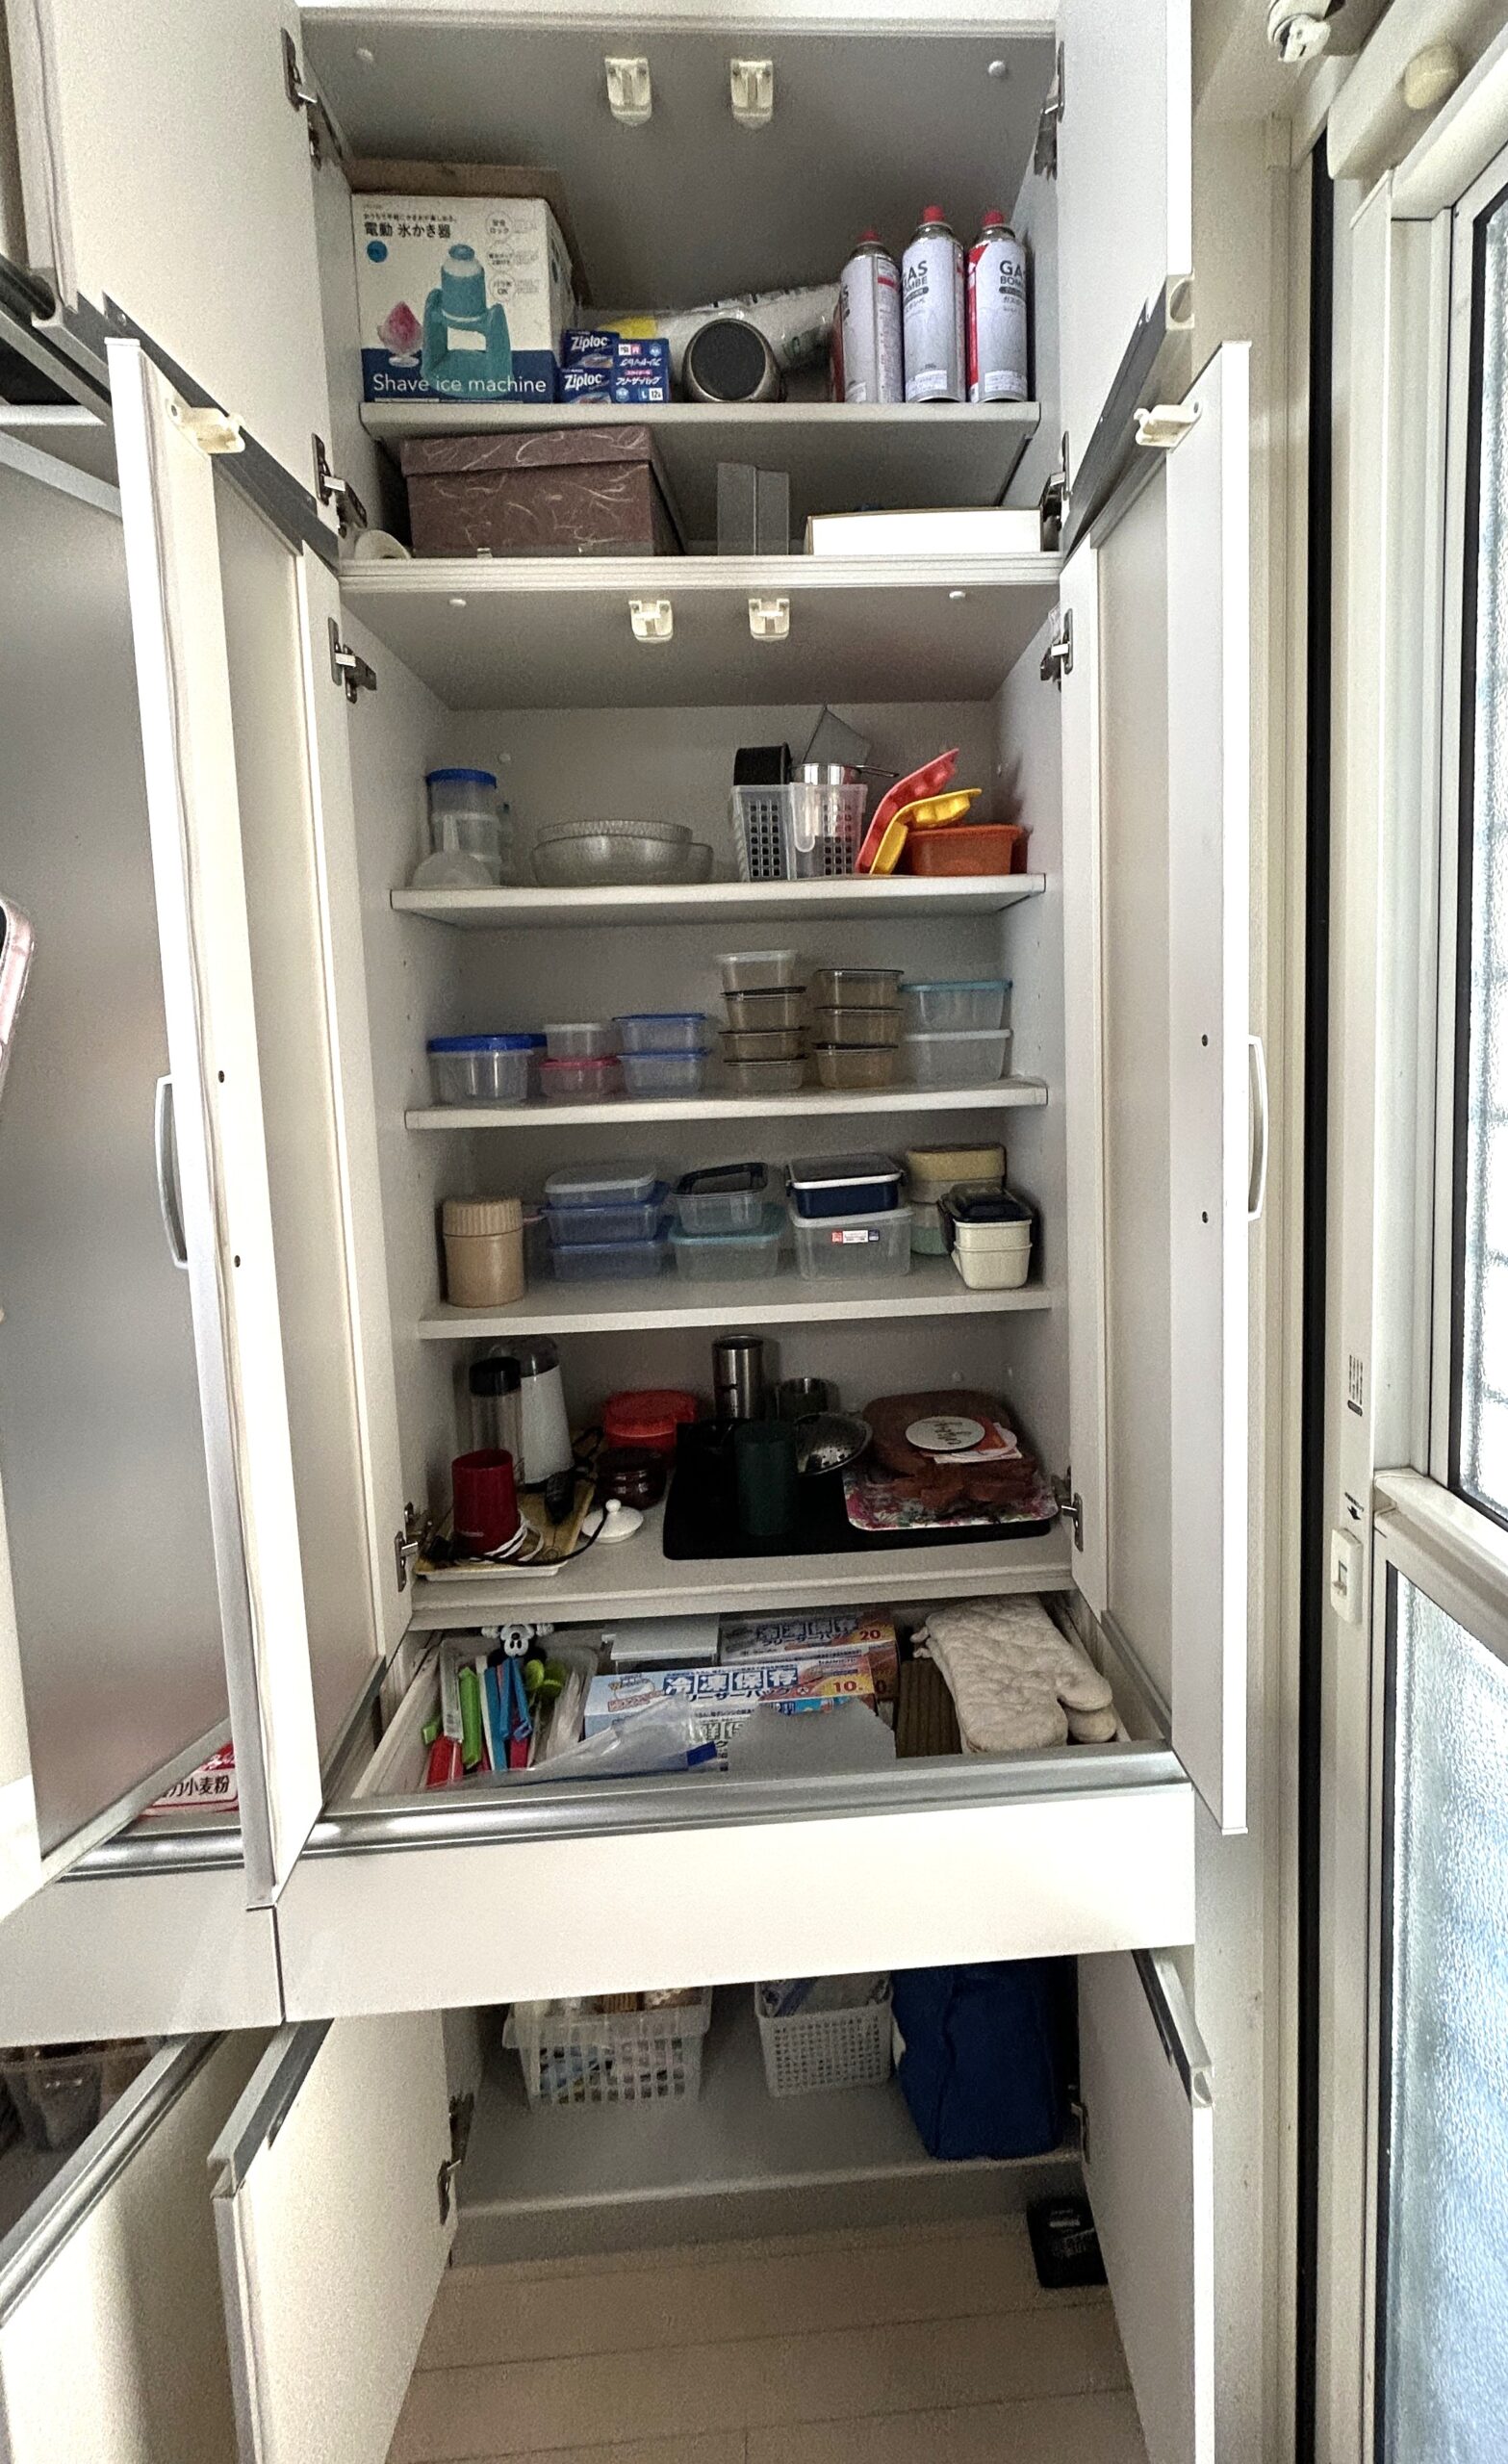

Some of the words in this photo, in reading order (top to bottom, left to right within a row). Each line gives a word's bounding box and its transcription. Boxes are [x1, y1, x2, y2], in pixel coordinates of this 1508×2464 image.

[365, 221, 393, 237] 電動
[397, 223, 450, 239] 氷かき器
[903, 260, 928, 280] AS
[1000, 260, 1025, 278] GA
[571, 335, 608, 352] Ziploc
[373, 374, 429, 392] Shave
[436, 375, 462, 392] ice
[469, 375, 547, 393] machine
[564, 372, 603, 391] Ziploc
[616, 375, 663, 386] フリーザーバッグ
[859, 1629, 882, 1641] 20
[664, 1667, 799, 1696] 冷凍保存
[687, 1685, 790, 1703] リーザーバッグ
